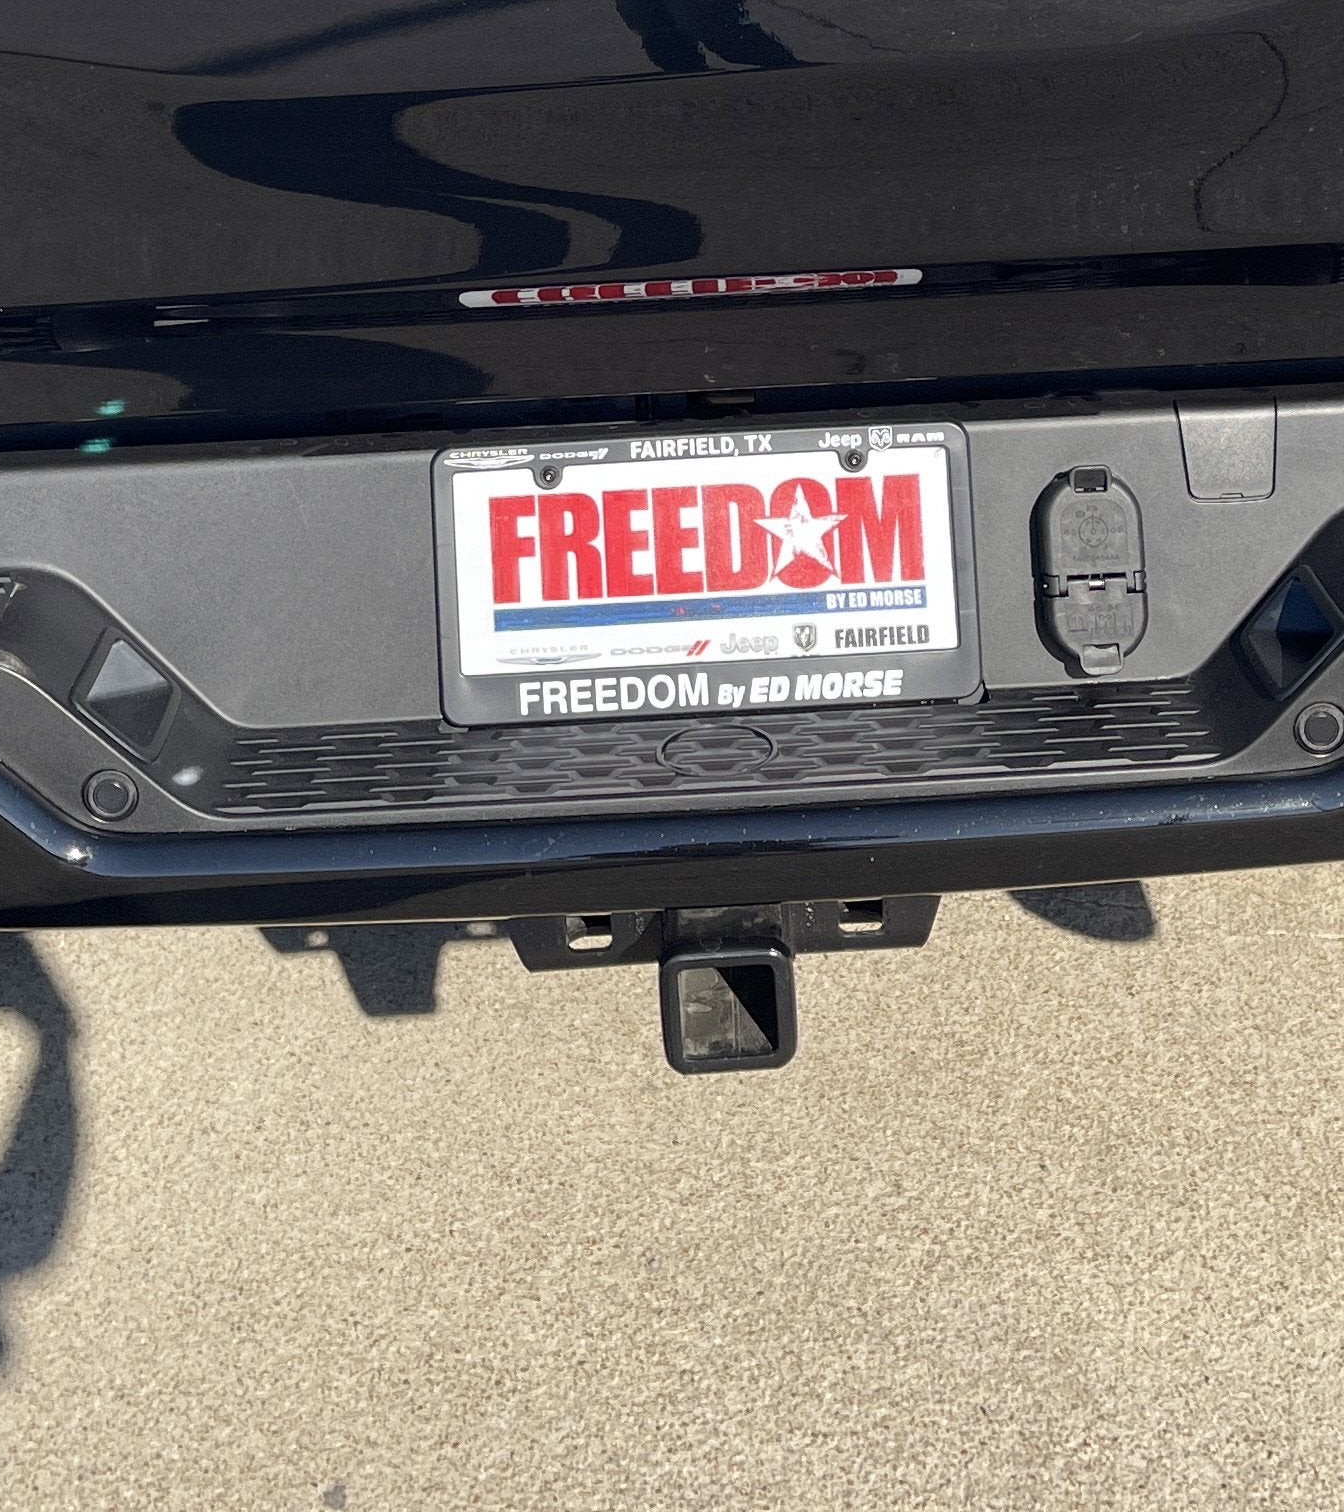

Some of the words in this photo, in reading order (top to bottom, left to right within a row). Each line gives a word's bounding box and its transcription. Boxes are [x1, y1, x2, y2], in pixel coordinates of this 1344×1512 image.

[630, 437, 739, 459] FAIRFIELD,
[743, 434, 773, 453] TX
[818, 432, 862, 449] Jeep
[896, 431, 945, 444] RAM
[449, 448, 529, 459] CHRYSLER
[488, 473, 926, 604] FREEDOM
[826, 593, 845, 610] BY
[847, 591, 867, 608] ED
[870, 588, 922, 607] MORSE
[720, 633, 779, 655] Jeep
[834, 624, 930, 649] FAIRFIELD
[519, 672, 709, 716] FREEDOM
[717, 683, 745, 708] By
[749, 678, 792, 704] ED
[794, 669, 904, 701] MORSE
